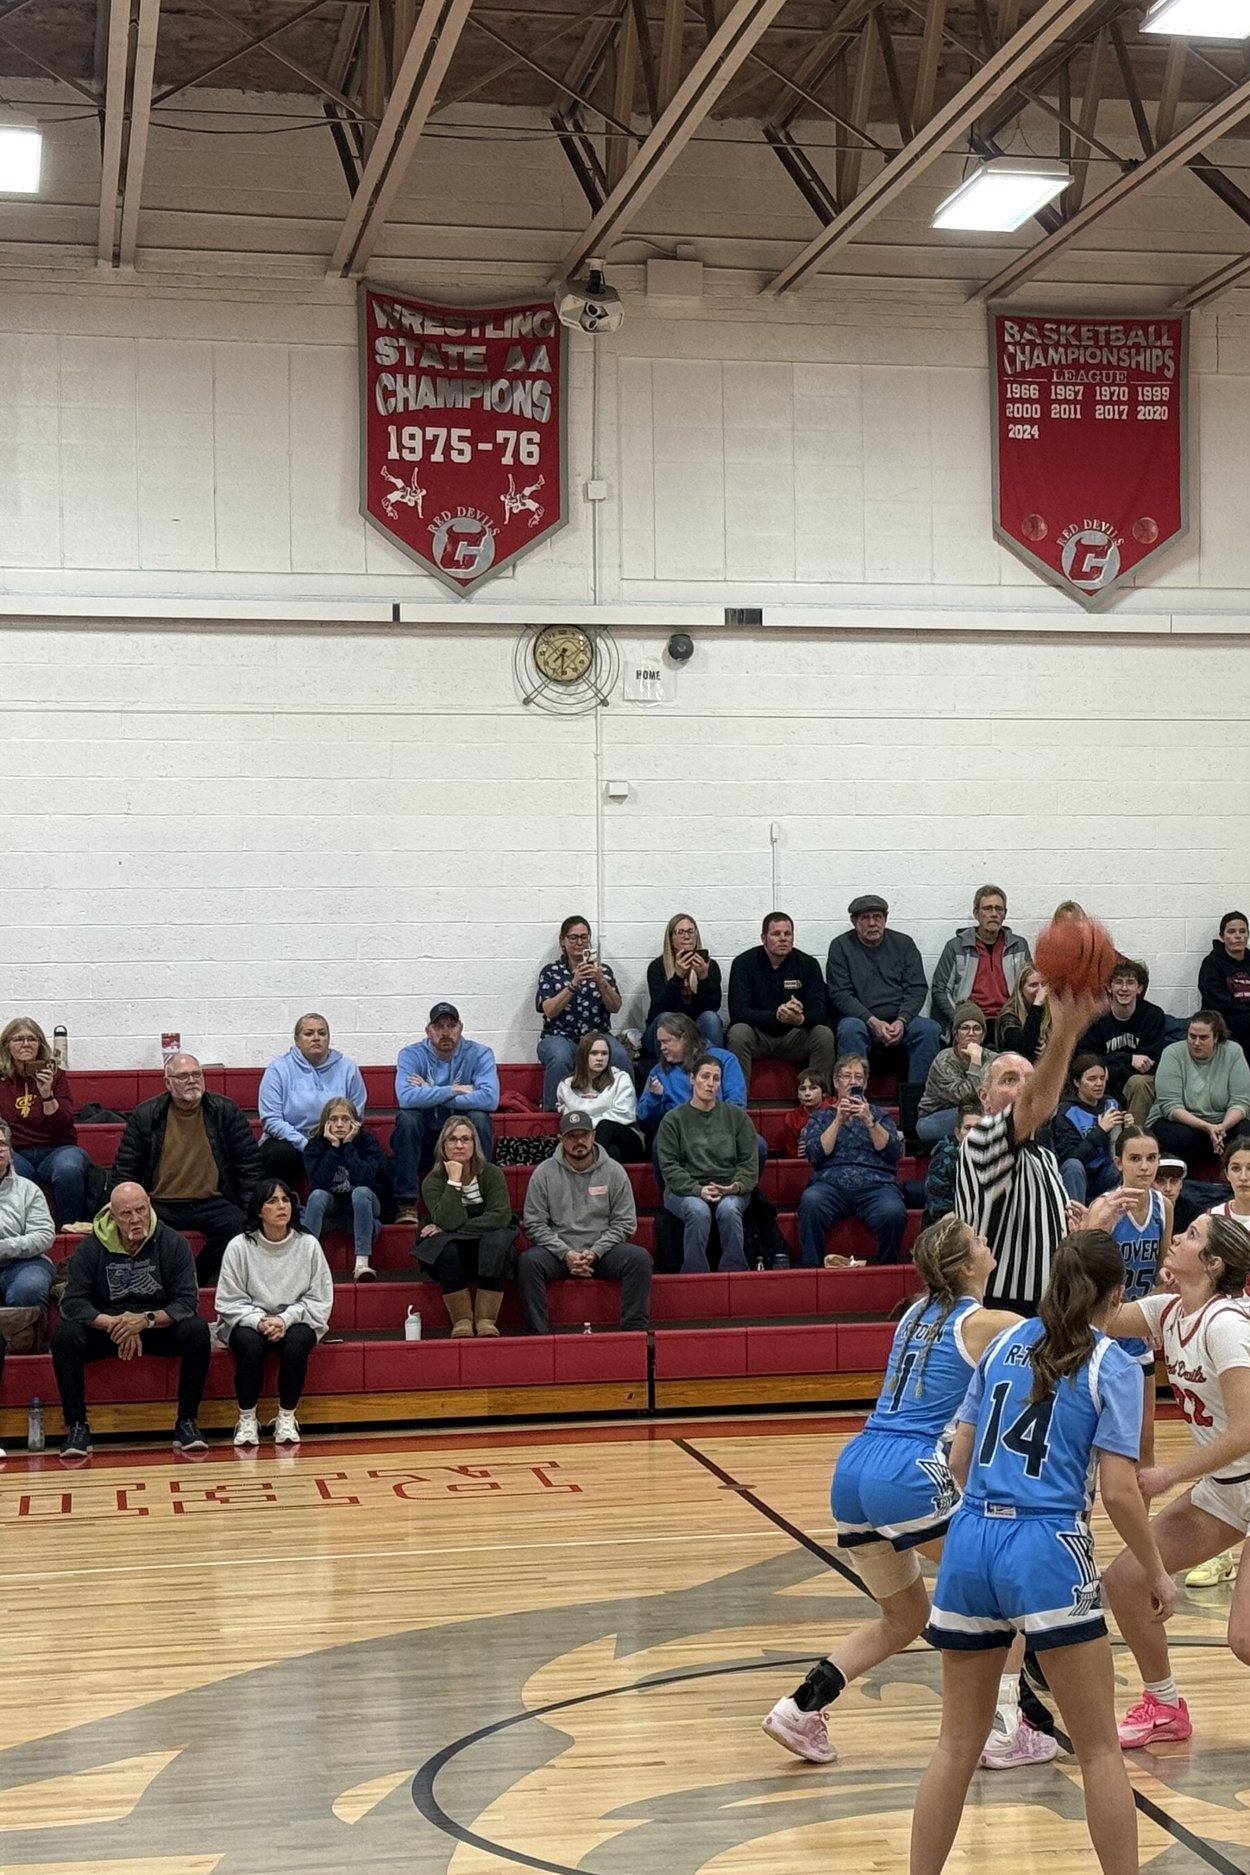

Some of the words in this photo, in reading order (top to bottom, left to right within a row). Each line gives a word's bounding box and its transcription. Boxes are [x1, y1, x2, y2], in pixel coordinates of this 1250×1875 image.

[372, 299, 555, 338] WRESTLING
[1004, 320, 1174, 346] BASKETBALL
[375, 336, 488, 372] STATE
[507, 345, 552, 373] AA
[1003, 344, 1175, 379] CHAMPIONSHIPS
[1006, 383, 1039, 399] 1966
[1050, 385, 1084, 400] 1967
[1095, 386, 1129, 401] 1970
[1137, 386, 1170, 401] 1999
[1051, 369, 1127, 384] LEAGUE
[375, 372, 552, 423] CHAMPIONS
[1006, 403, 1041, 418] 2000
[1050, 404, 1082, 419] 2011
[1095, 405, 1129, 420] 2017
[1137, 405, 1168, 420] 2020
[387, 425, 541, 465] 1975-76
[1008, 424, 1039, 439] 2024
[456, 506, 500, 537] DEVILS
[1056, 523, 1079, 547] RED
[1083, 519, 1125, 547] DEVILS
[1119, 1238, 1160, 1262] OVER
[887, 1351, 919, 1413] 1
[978, 1380, 1059, 1480] 14
